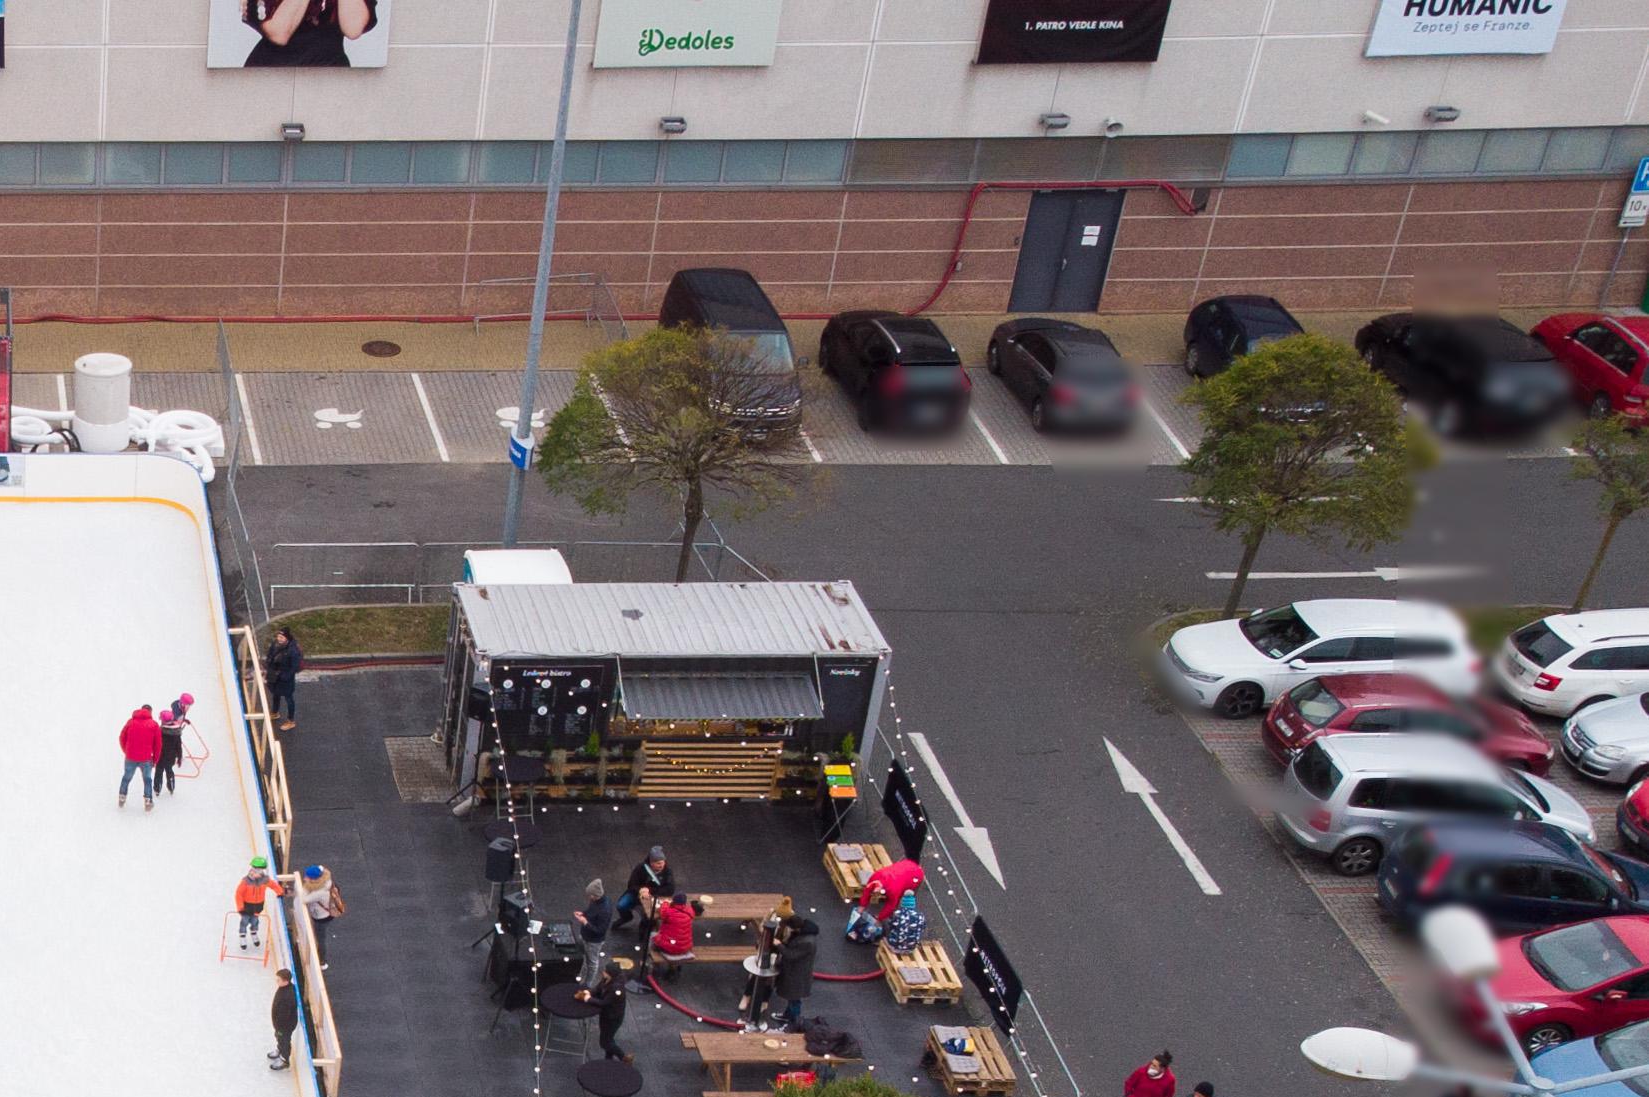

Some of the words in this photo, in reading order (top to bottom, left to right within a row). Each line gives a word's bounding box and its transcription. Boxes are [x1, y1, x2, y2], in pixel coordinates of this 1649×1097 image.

[1403, 0, 1553, 17] HUMANIC
[1024, 22, 1033, 31] 1.
[1035, 21, 1067, 31] PATRO
[1068, 20, 1097, 30] VEDLE
[1098, 20, 1124, 30] KINA
[1413, 21, 1460, 35] Zeptej
[1463, 24, 1479, 32] se
[638, 28, 735, 56] Dedoles
